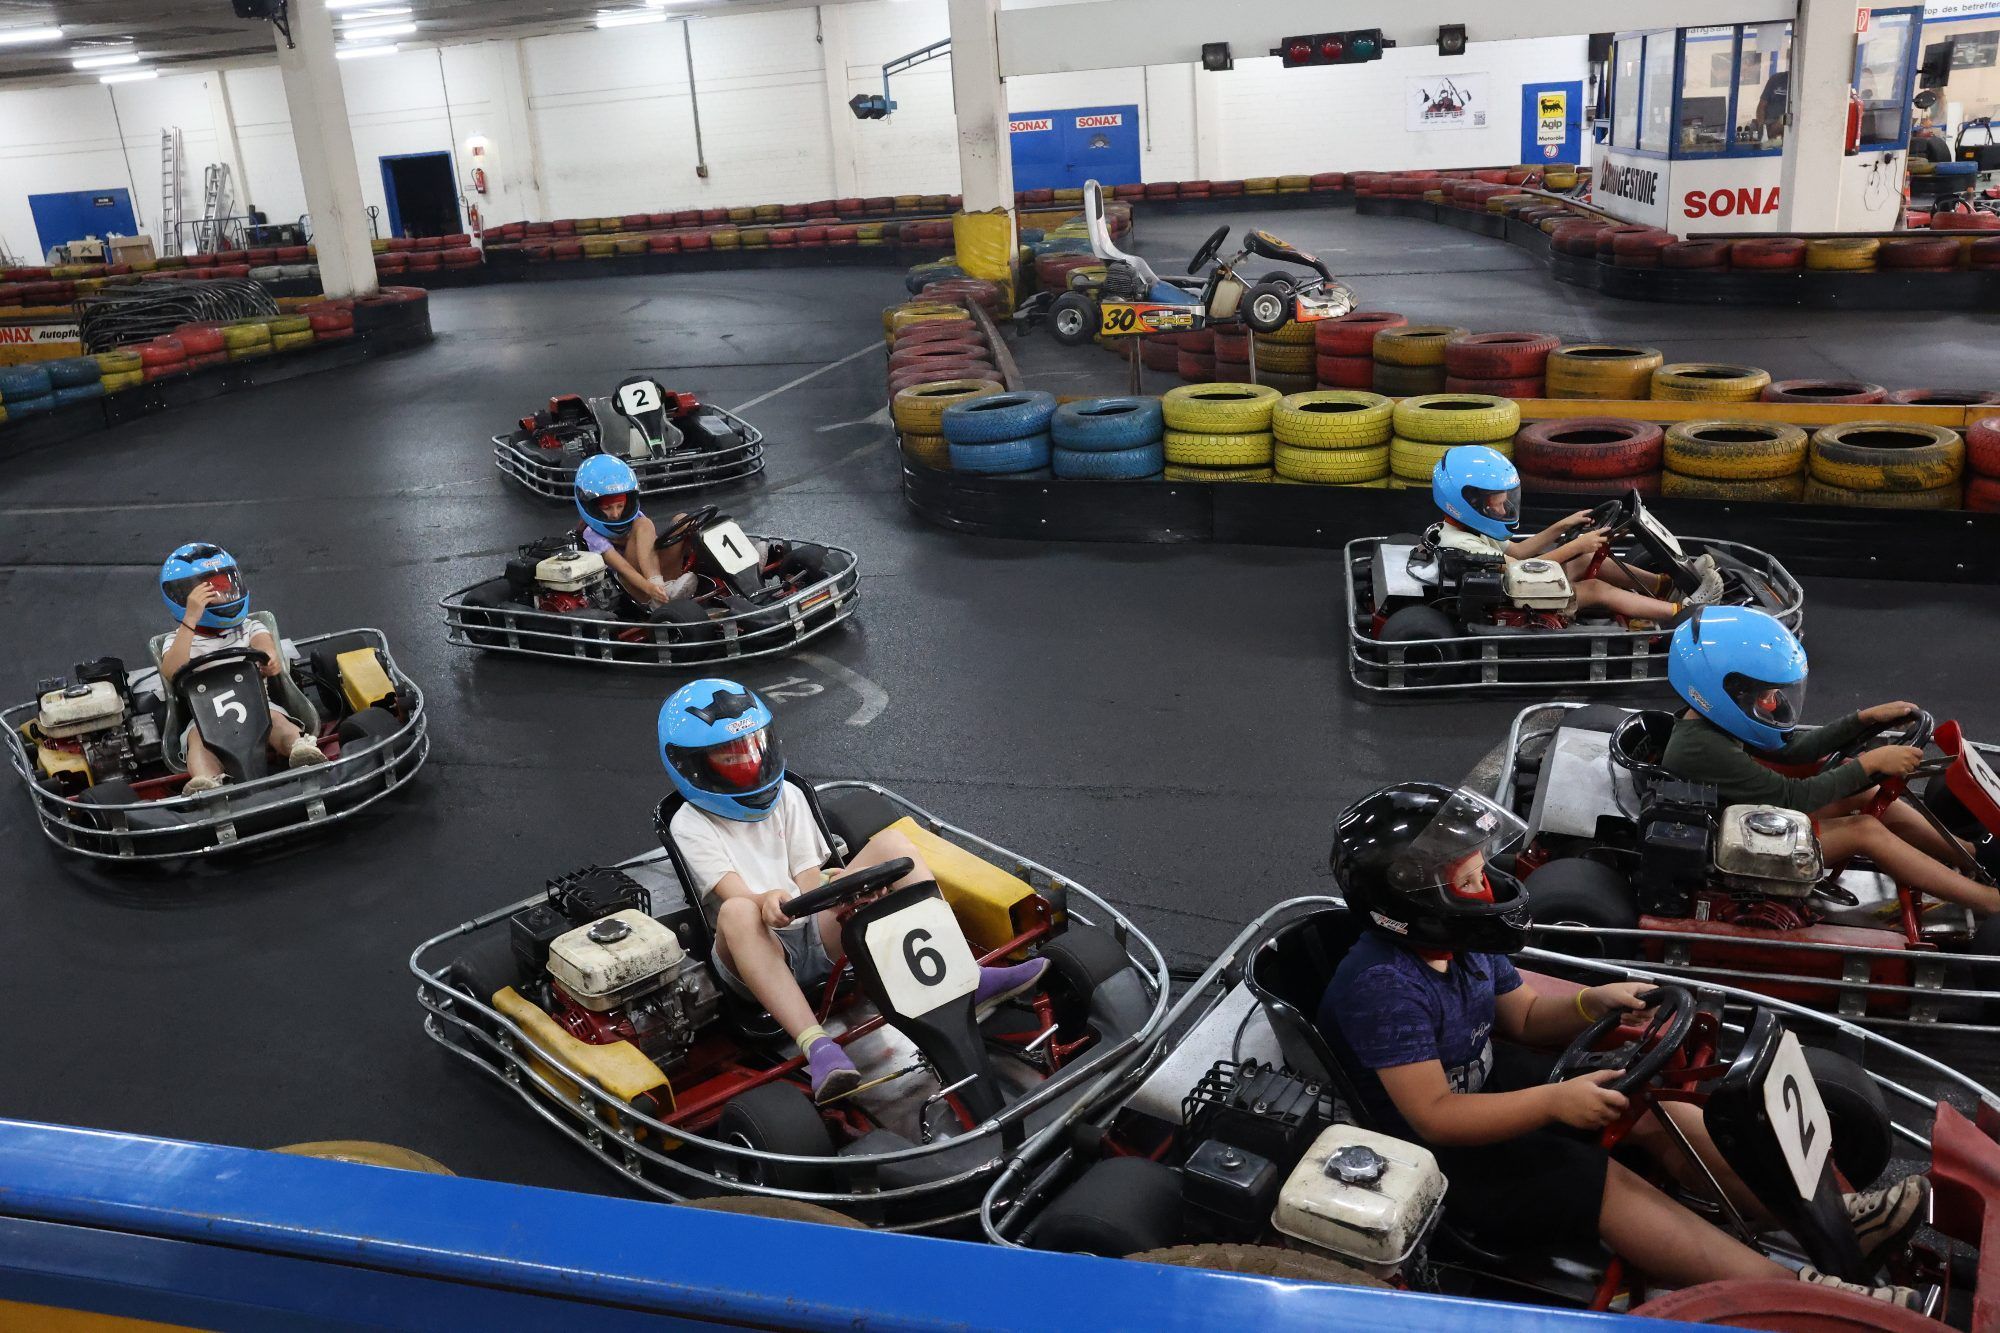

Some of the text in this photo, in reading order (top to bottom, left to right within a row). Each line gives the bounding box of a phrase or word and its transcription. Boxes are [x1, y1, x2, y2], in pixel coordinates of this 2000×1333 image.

[1010, 120, 1049, 132] SONAX
[1078, 115, 1118, 127] SONAX
[1541, 120, 1563, 130] Agip
[1600, 155, 1658, 205] BRIDGESTONE
[1104, 307, 1136, 331] 30
[632, 388, 650, 408] 2
[722, 534, 743, 559] 1
[758, 676, 825, 704] 12
[212, 689, 248, 724] 5
[902, 927, 947, 987] 6
[1782, 1073, 1816, 1161] 2
